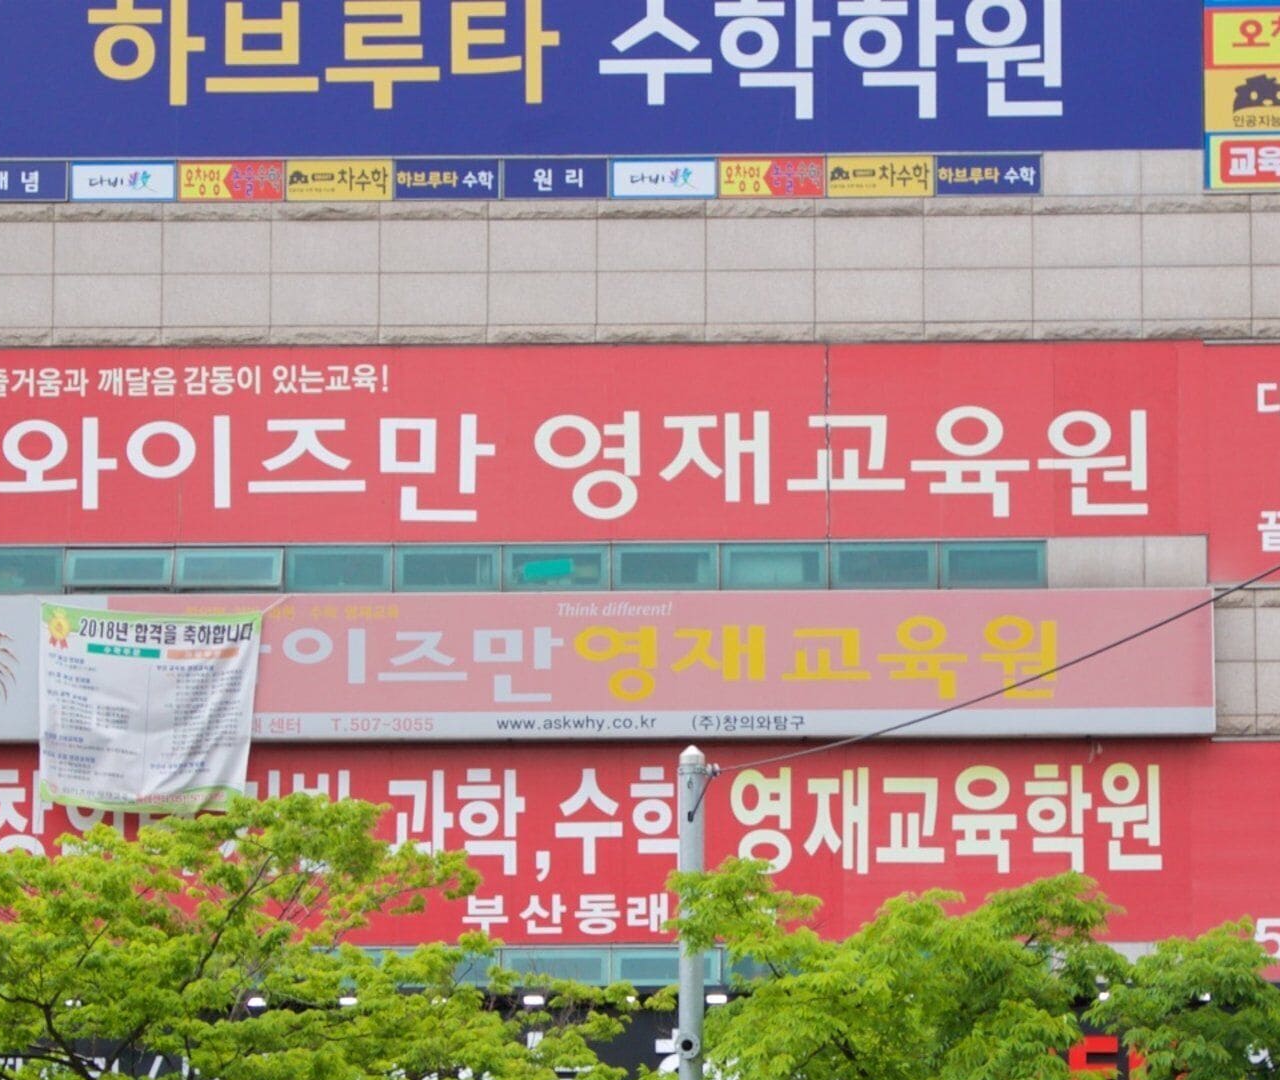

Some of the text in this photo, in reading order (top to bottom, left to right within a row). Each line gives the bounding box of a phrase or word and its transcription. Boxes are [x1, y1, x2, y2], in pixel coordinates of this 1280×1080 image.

[599, 0, 1063, 119] 수학학원
[337, 167, 388, 194] 차수학
[397, 169, 494, 191] 하브루타 수학
[878, 163, 930, 191] 차수학
[937, 165, 1037, 188] 하브루타 수학
[97, 366, 177, 396] 깨달음
[184, 365, 261, 395] 감동이
[534, 405, 1149, 520] 영재교육원
[557, 602, 673, 616] Think different!
[79, 617, 254, 645] 2018년 합격을 축하합니다
[257, 627, 564, 702] 이즈만
[269, 714, 806, 734] 센터 T.507-3055 www.askwhy.co.kr (주)창의와탐구
[730, 762, 1164, 876] 영재교육학원
